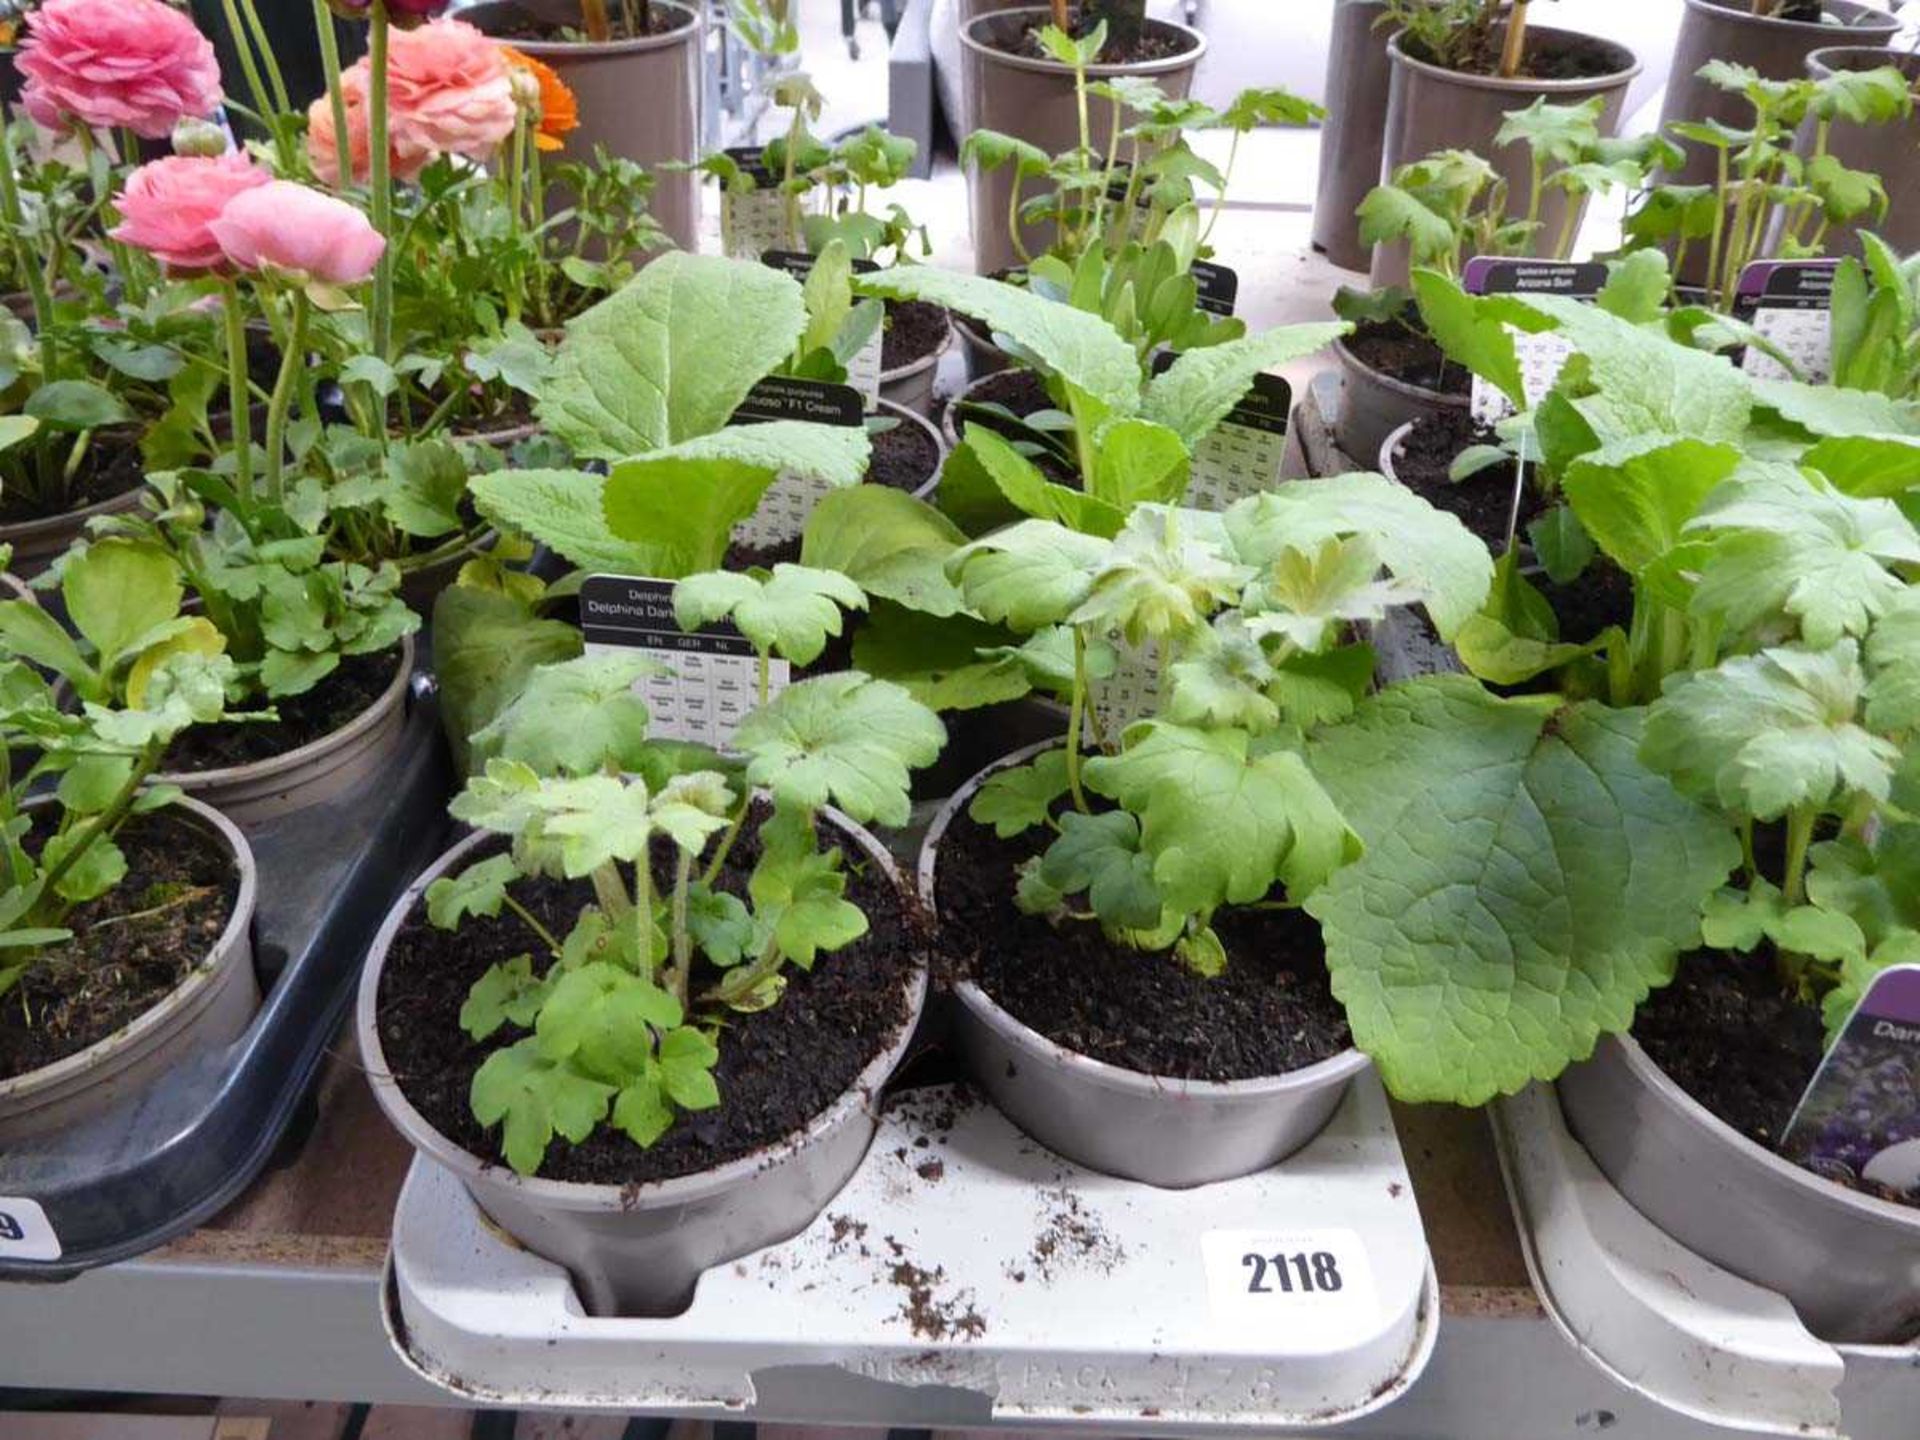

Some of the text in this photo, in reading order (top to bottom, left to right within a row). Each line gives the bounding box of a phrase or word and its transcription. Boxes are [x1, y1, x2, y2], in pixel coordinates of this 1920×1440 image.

[1516, 277, 1551, 288] Arizona
[805, 400, 842, 416] Cream
[588, 600, 644, 617] Delphina
[1241, 1251, 1343, 1293] 2118
